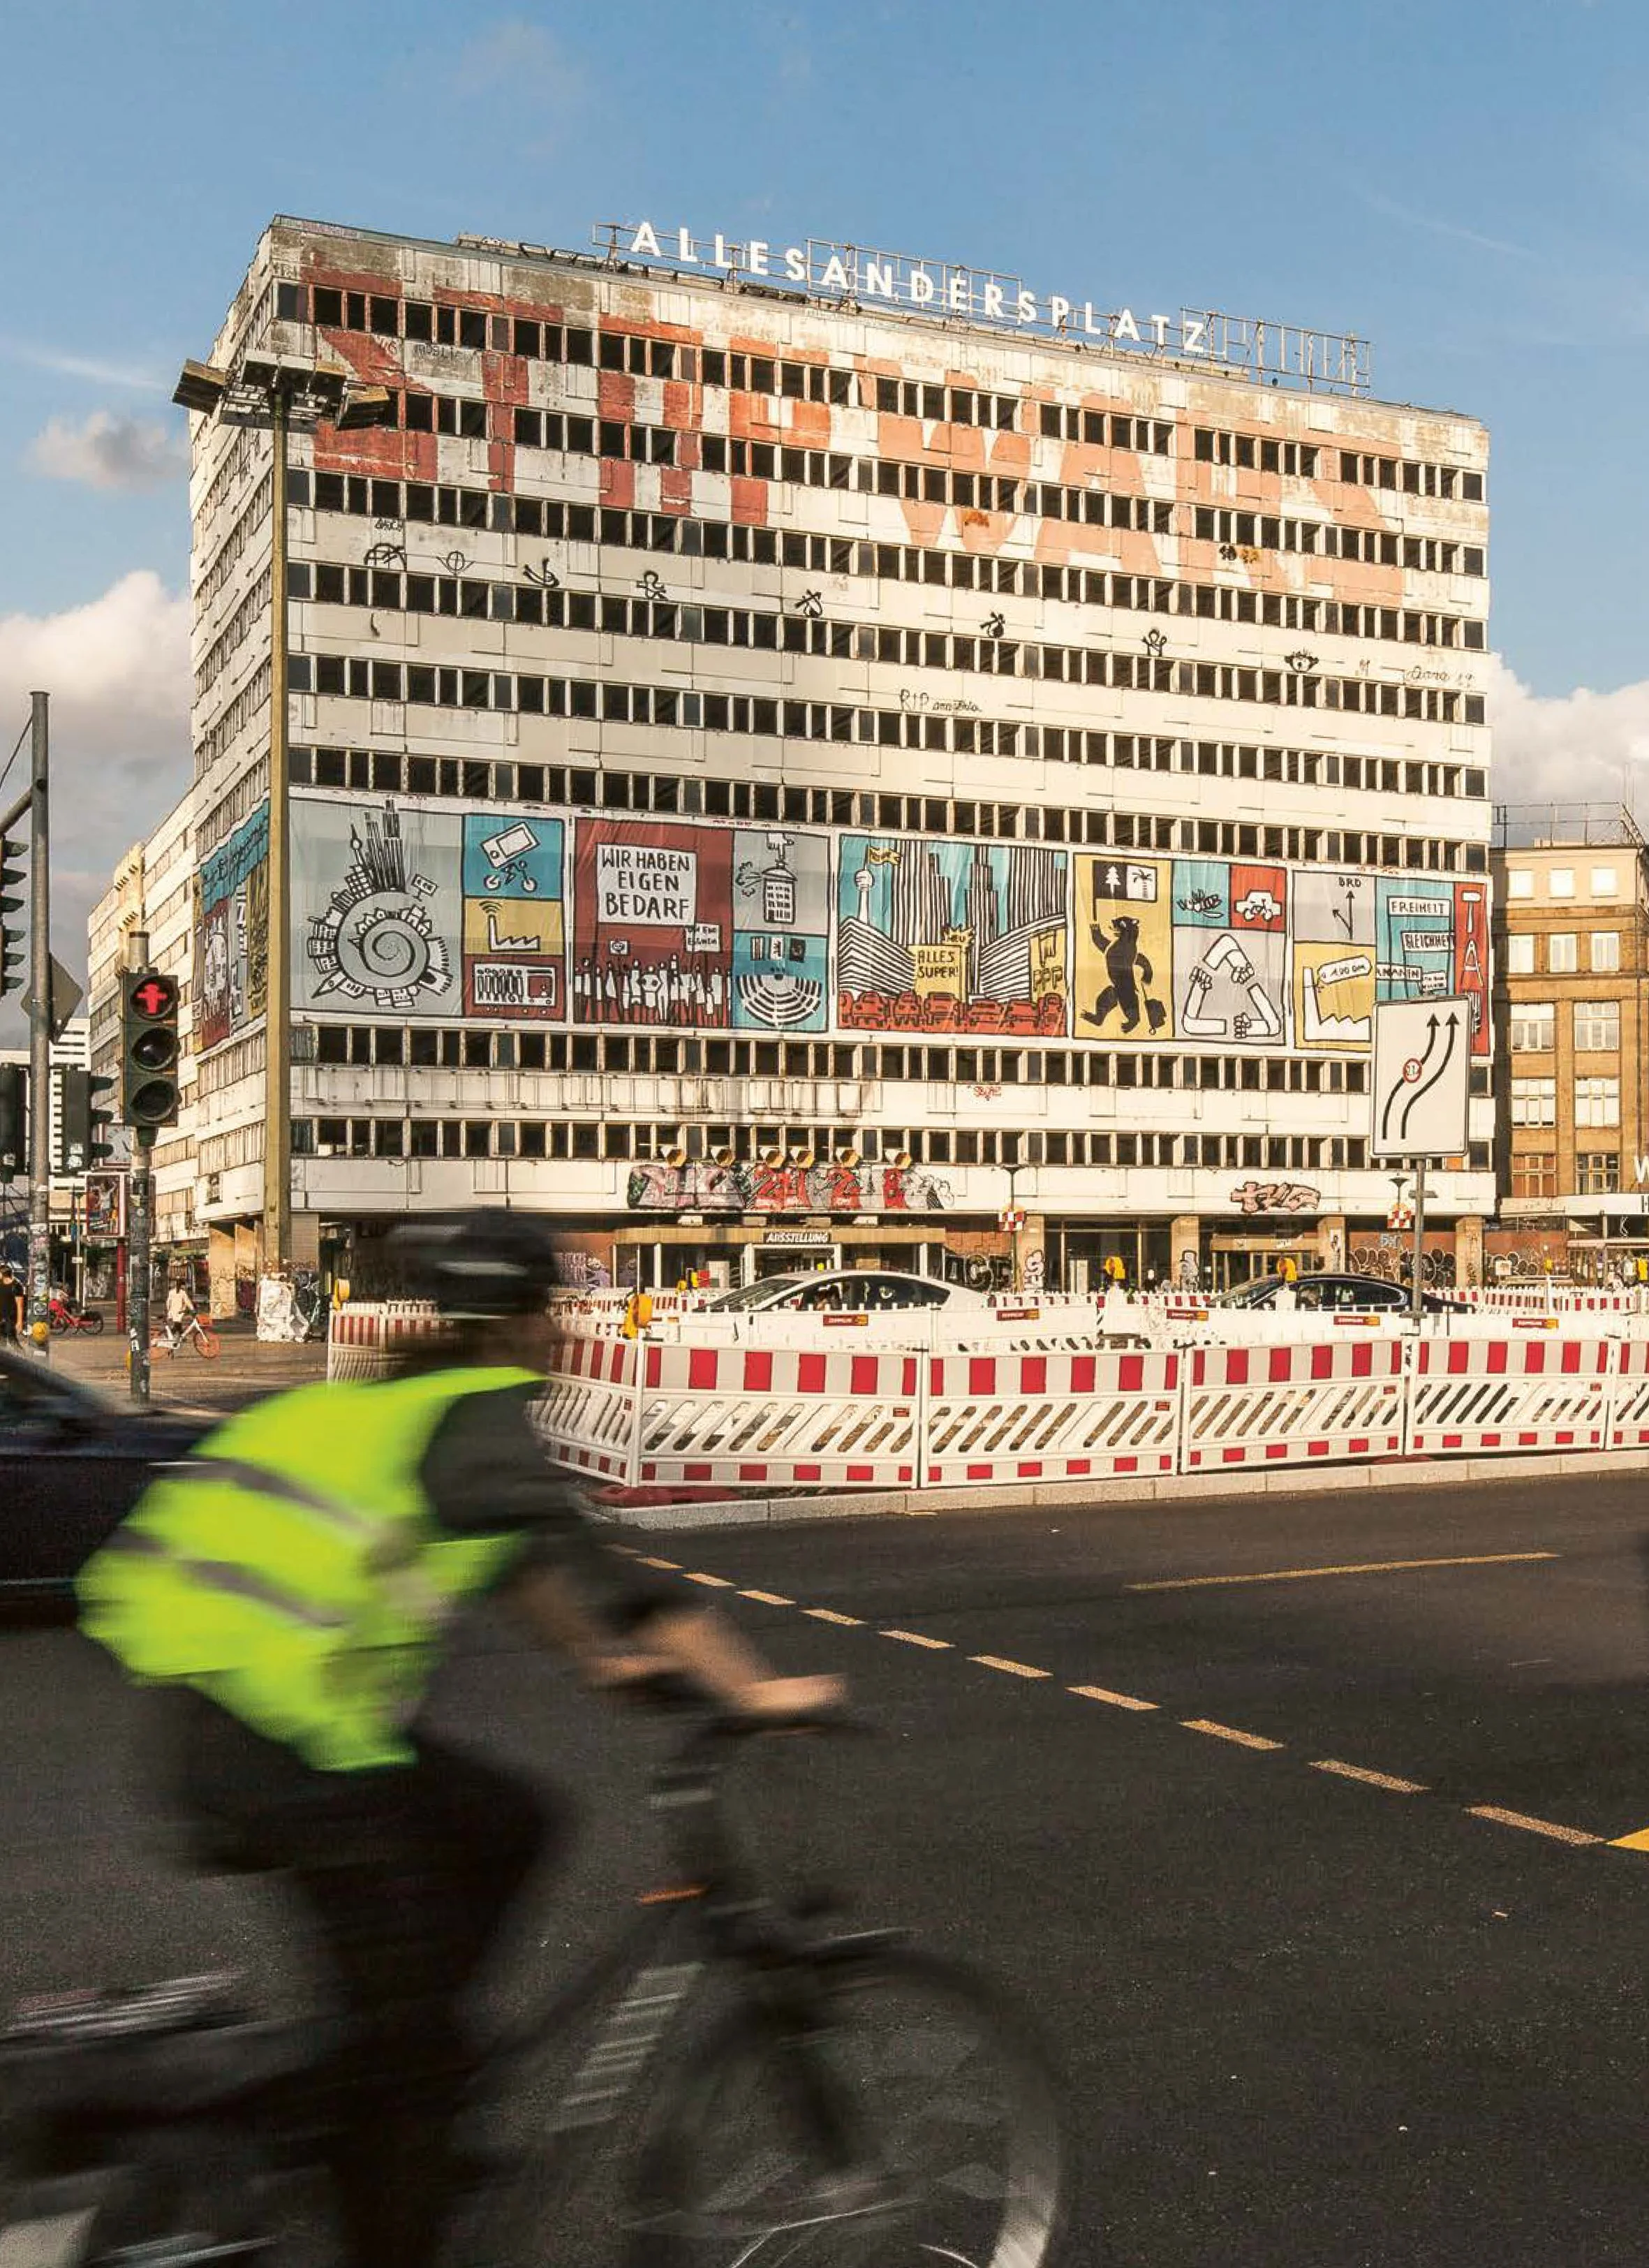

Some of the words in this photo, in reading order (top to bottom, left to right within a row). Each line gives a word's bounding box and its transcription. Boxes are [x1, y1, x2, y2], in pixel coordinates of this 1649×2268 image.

[628, 221, 1208, 355] ALLESANDERSPLATZ
[601, 848, 631, 869] WIR
[636, 850, 690, 871] HABEN
[618, 871, 679, 891] EIGEN
[605, 892, 690, 920] BEDARF
[1391, 901, 1444, 914] FREIHEIT
[917, 950, 956, 964] ALLES
[917, 966, 959, 979] SUPER!
[765, 1231, 829, 1244] AUSSTELLUNG
